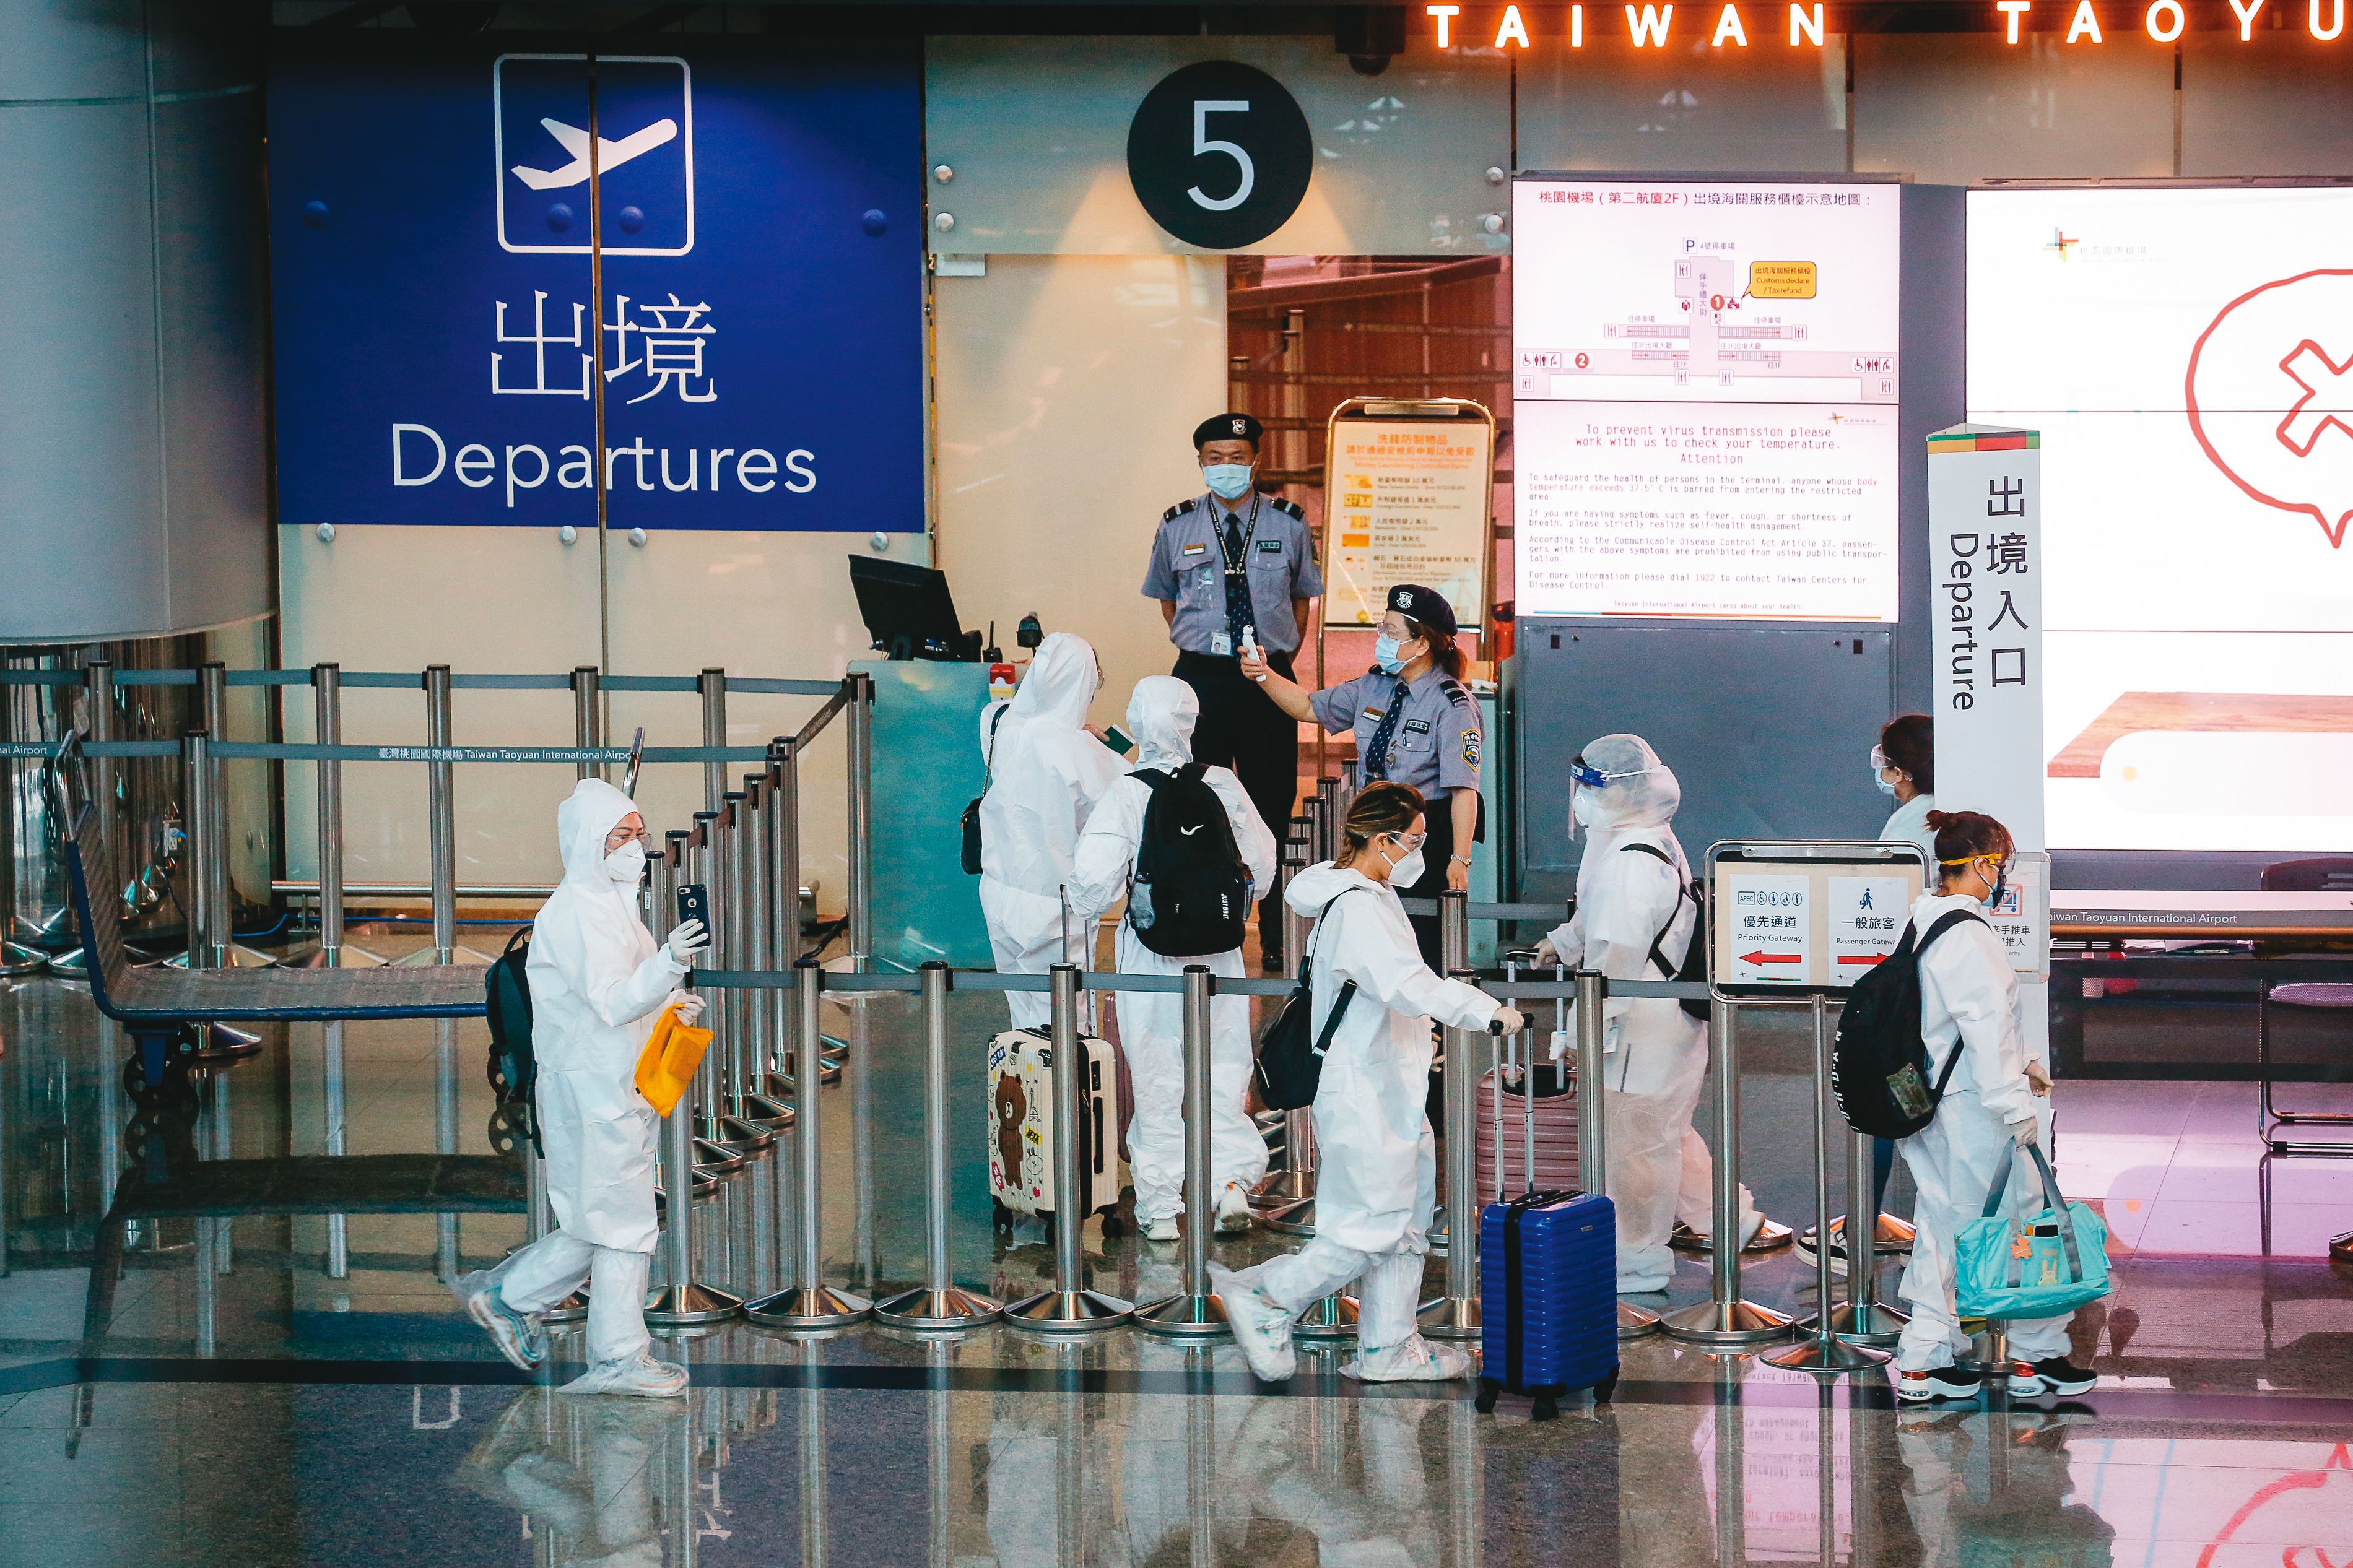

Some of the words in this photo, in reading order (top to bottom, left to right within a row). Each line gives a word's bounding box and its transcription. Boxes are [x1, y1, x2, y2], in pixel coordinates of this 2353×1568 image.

[1426, 2, 1824, 49] TAIWAN
[1186, 100, 1255, 211] 5
[1686, 240, 1695, 252] P
[490, 290, 718, 405] 出境
[1586, 424, 1598, 434] To
[1607, 425, 1653, 436] prevent
[1661, 425, 1694, 435] virus
[1702, 426, 1782, 436] transmission
[1791, 427, 1831, 437] please
[1576, 436, 1601, 446] work
[1610, 437, 1635, 446] with
[1644, 439, 1656, 447] us
[1665, 438, 1677, 447] to
[1685, 438, 1717, 448] check
[1726, 440, 1752, 449] your
[1681, 453, 1742, 464] Attention
[393, 423, 817, 508] Departures
[1529, 472, 1539, 481] To
[1544, 473, 1589, 482] safeguard
[1594, 474, 1609, 482] the
[1614, 474, 1644, 482] health
[1649, 475, 1659, 483] of
[1720, 475, 1735, 483] the
[1826, 477, 1852, 485] whose
[1857, 478, 1877, 487] body
[1529, 483, 1584, 492] temperature
[1659, 484, 1664, 492] C
[1669, 485, 1679, 493] is
[1684, 485, 1714, 493] barred
[1720, 485, 1740, 493] from
[1744, 486, 1785, 495] entering
[1791, 486, 1806, 495] the
[1811, 487, 1861, 495] restricted
[1529, 508, 1538, 517] If
[1584, 510, 1614, 519] having
[1619, 511, 1659, 519] symptoms
[1664, 511, 1685, 519] such
[1791, 513, 1837, 521] shortness
[1842, 513, 1851, 521] of
[1569, 519, 1599, 527] please
[1604, 519, 1645, 529] strictly
[1650, 520, 1685, 529] realize
[1690, 521, 1745, 529] self-health
[1529, 535, 1574, 544] According
[1594, 536, 1609, 544] the
[1614, 536, 1675, 545] Communicable
[1679, 537, 1715, 546] Disease
[1720, 538, 1755, 547] Control
[1760, 539, 1776, 547] Act
[1781, 539, 1816, 547] Article
[1580, 545, 1594, 553] the
[1599, 546, 1624, 554] above
[1630, 547, 1669, 555] symptoms
[1695, 548, 1746, 556] prohibited
[1751, 548, 1771, 556] from
[1776, 548, 1801, 558] using
[1806, 549, 1837, 558] public
[1529, 571, 1544, 579] For
[1575, 571, 1630, 580] information
[1635, 573, 1665, 581] please
[1670, 573, 1689, 581] dial
[1695, 573, 1715, 582] 1922
[1721, 574, 1730, 582] to
[1735, 574, 1770, 583] contact
[1777, 574, 1806, 583] Taiwan
[1811, 575, 1846, 584] Centers
[1986, 475, 2029, 687] 出境入口
[1529, 580, 1564, 589] Disease
[1942, 532, 1979, 711] Departure
[12, 745, 48, 756] Airport
[464, 750, 498, 759] Taiwan
[499, 750, 540, 761] Taoyuan
[542, 750, 603, 760] International
[1743, 915, 1797, 929] 優先通道
[1842, 917, 1895, 930] 一般旅客
[2080, 912, 2125, 925] Taoyuan
[2128, 912, 2196, 924] International
[2198, 913, 2237, 926] Airport
[1738, 933, 1767, 943] Priority
[1768, 933, 1803, 943] Gateway
[1836, 938, 1870, 946] Passenger
[2002, 937, 2025, 946] 推入
